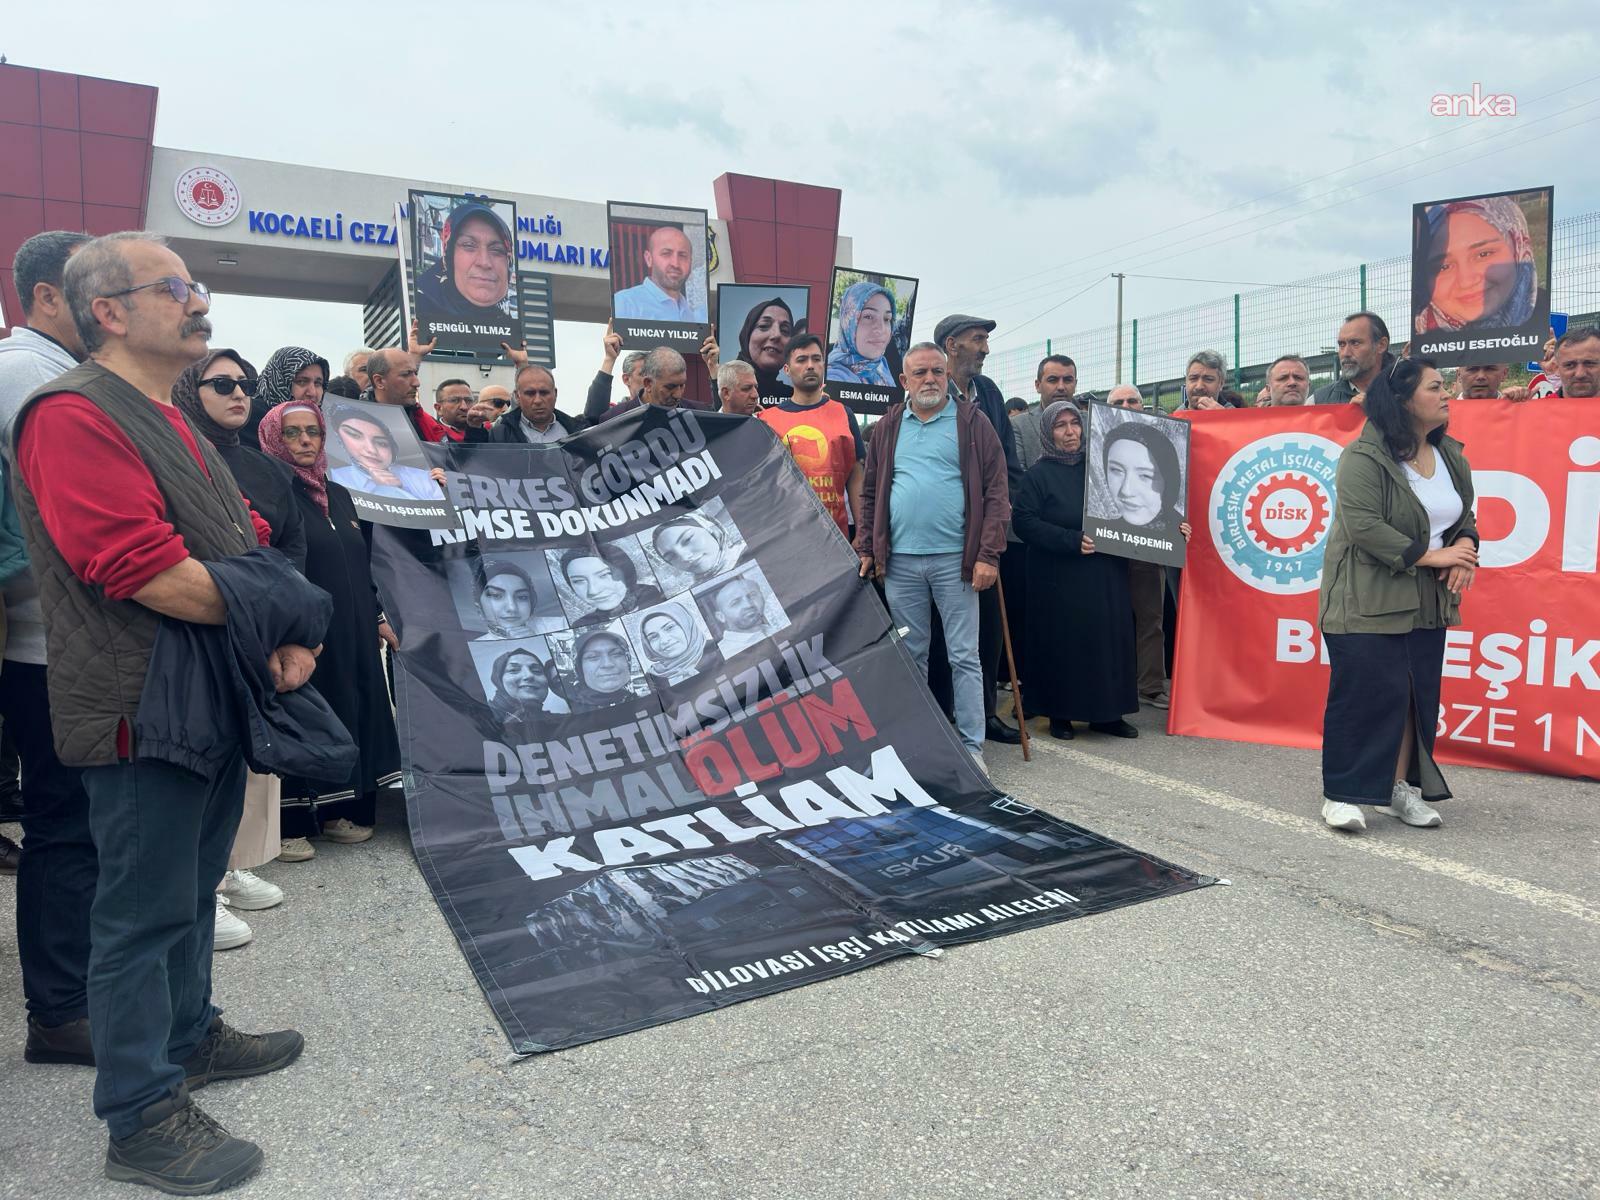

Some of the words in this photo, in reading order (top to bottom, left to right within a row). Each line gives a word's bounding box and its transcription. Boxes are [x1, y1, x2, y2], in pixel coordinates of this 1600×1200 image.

[249, 210, 343, 241] KOCAELİ
[517, 240, 585, 266] UMLARI
[517, 214, 562, 236] NLIĞI
[429, 321, 472, 334] ŞENGÜL
[473, 325, 512, 336] YILMAZ
[627, 327, 666, 339] TUNCAY
[667, 330, 699, 340] YILDIZ
[1420, 341, 1466, 354] CANSU
[1469, 334, 1540, 351] ESETOĞLU
[762, 395, 791, 405] GÜLE
[840, 390, 863, 401] ESMA
[864, 391, 890, 403] GİKAN
[445, 470, 575, 511] ERKES
[580, 409, 707, 504] GÖRDÜ
[1236, 457, 1279, 489] METAL
[351, 496, 384, 512] UĞBA
[384, 504, 447, 517] TAŞDEMİR
[539, 450, 723, 538] DOKUNMADI
[1227, 491, 1248, 550] BİRLEŞİK
[1265, 501, 1308, 520] DİSK
[1096, 526, 1120, 541] NİSA
[1122, 532, 1174, 552] TAŞDEMİR
[1266, 559, 1303, 573] 1947
[1276, 617, 1600, 701] BEŞİK
[483, 633, 843, 788] DENETİMSİZLİK
[680, 677, 878, 797] ÖLÜM
[1534, 712, 1553, 753] 1
[507, 744, 939, 882] KATLİAM
[809, 936, 873, 963] İŞÇİ
